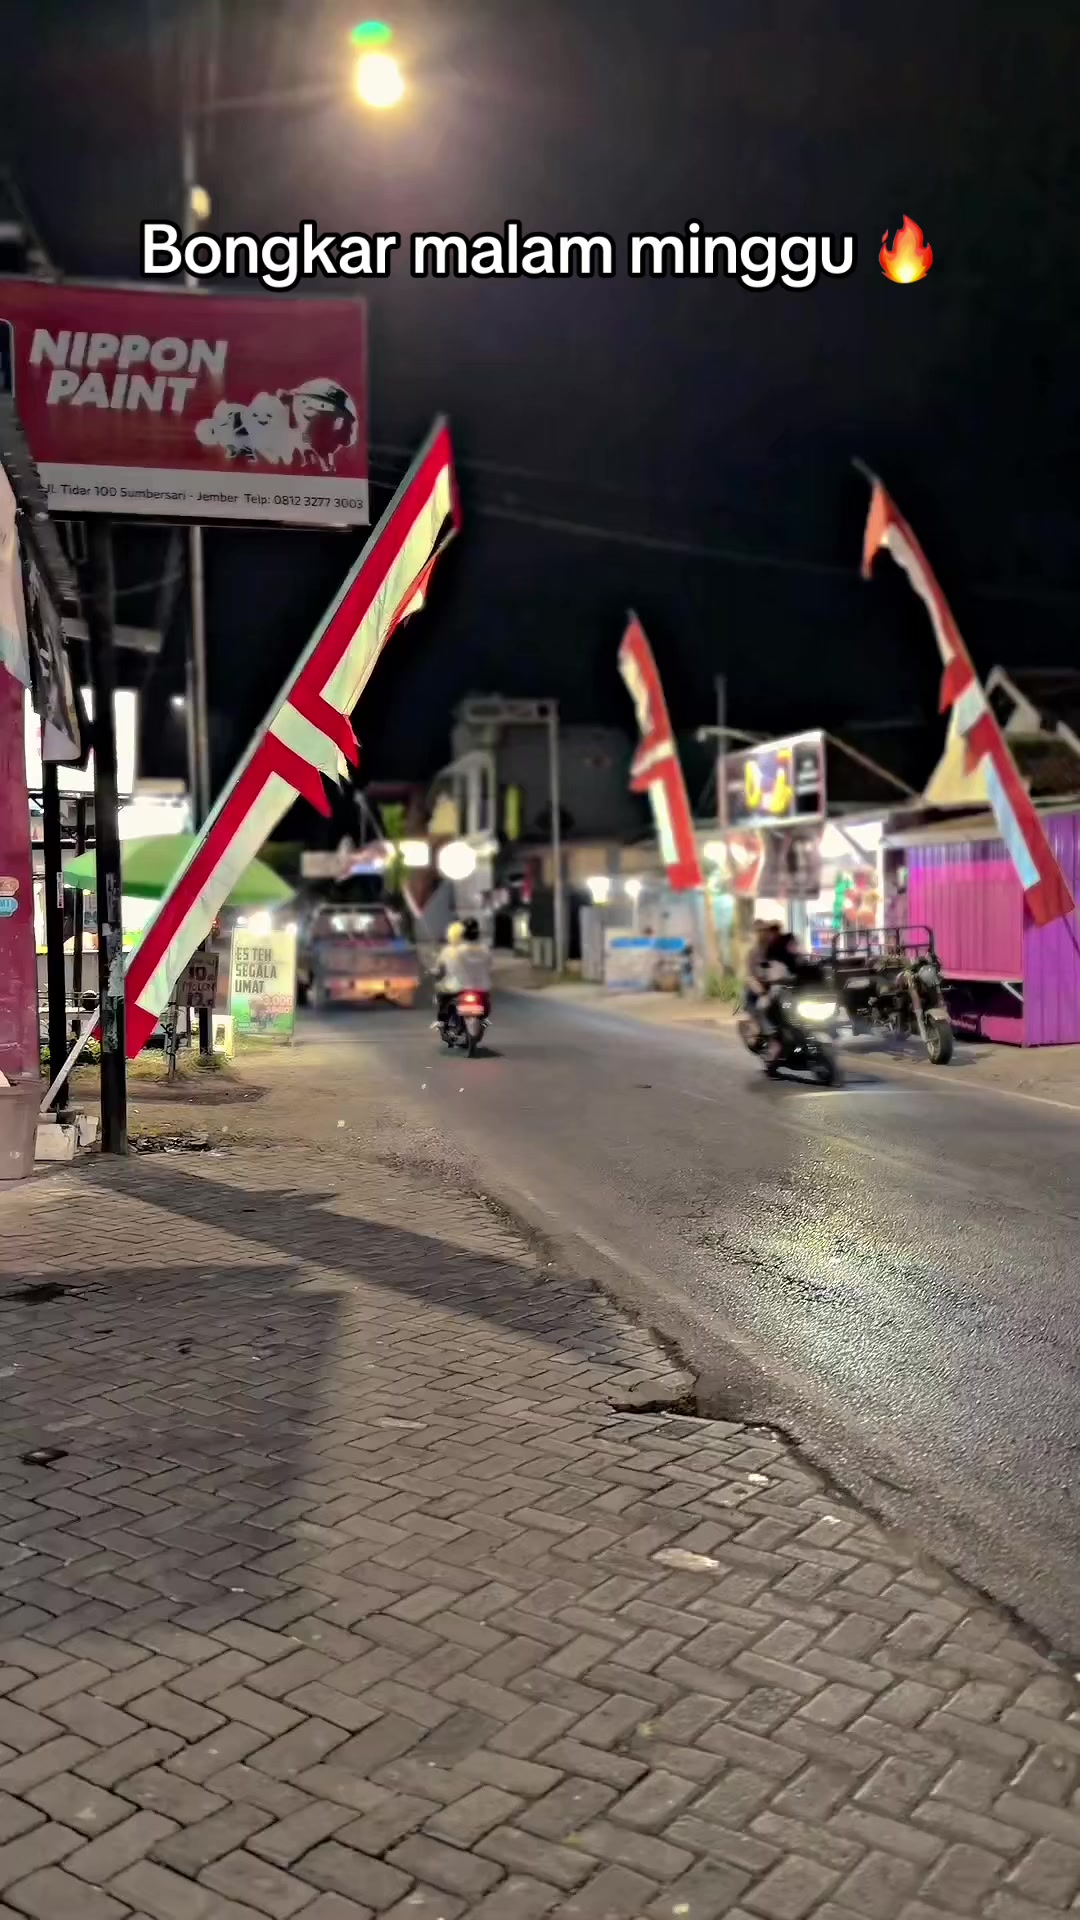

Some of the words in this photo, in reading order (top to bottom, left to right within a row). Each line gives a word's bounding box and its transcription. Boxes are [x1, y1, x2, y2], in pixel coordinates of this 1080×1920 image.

[29, 328, 229, 374] NIPPON
[46, 370, 198, 416] PAINT
[60, 484, 91, 495] Tidar
[94, 486, 117, 497] 100
[120, 487, 186, 500] Sumbersari
[196, 491, 238, 504] Jember
[244, 493, 271, 507] Telp:
[274, 494, 301, 506] 0812
[304, 495, 330, 508] 3277
[334, 497, 364, 509] 3003
[236, 946, 250, 960] ES
[252, 947, 272, 961] TEH
[235, 963, 277, 979] SEGALA
[234, 979, 265, 994] UMAT
